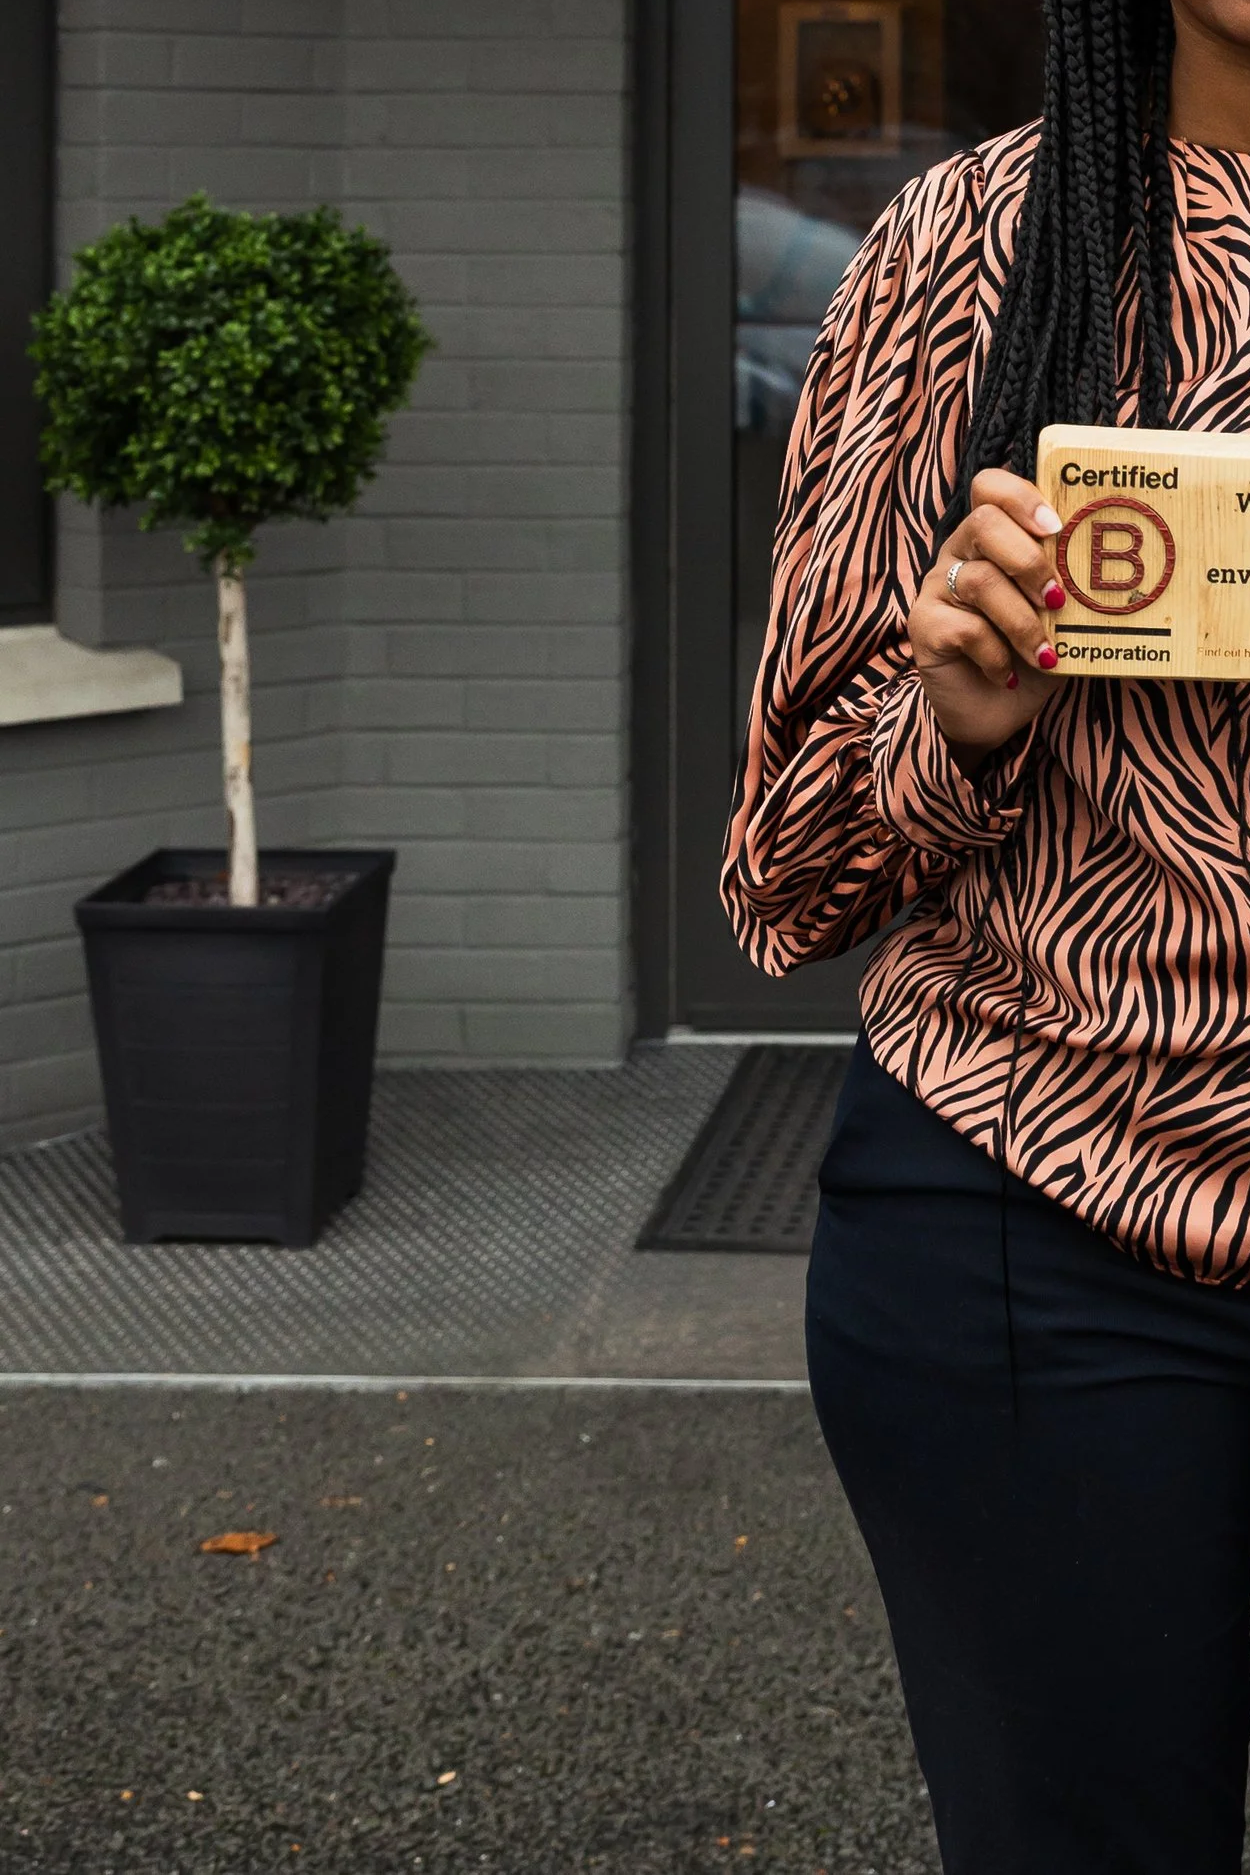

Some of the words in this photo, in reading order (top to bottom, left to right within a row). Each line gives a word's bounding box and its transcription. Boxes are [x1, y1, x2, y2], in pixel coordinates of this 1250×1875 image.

[1060, 462, 1179, 490] Certified
[1090, 520, 1145, 590] B
[1055, 640, 1171, 663] Corporation
